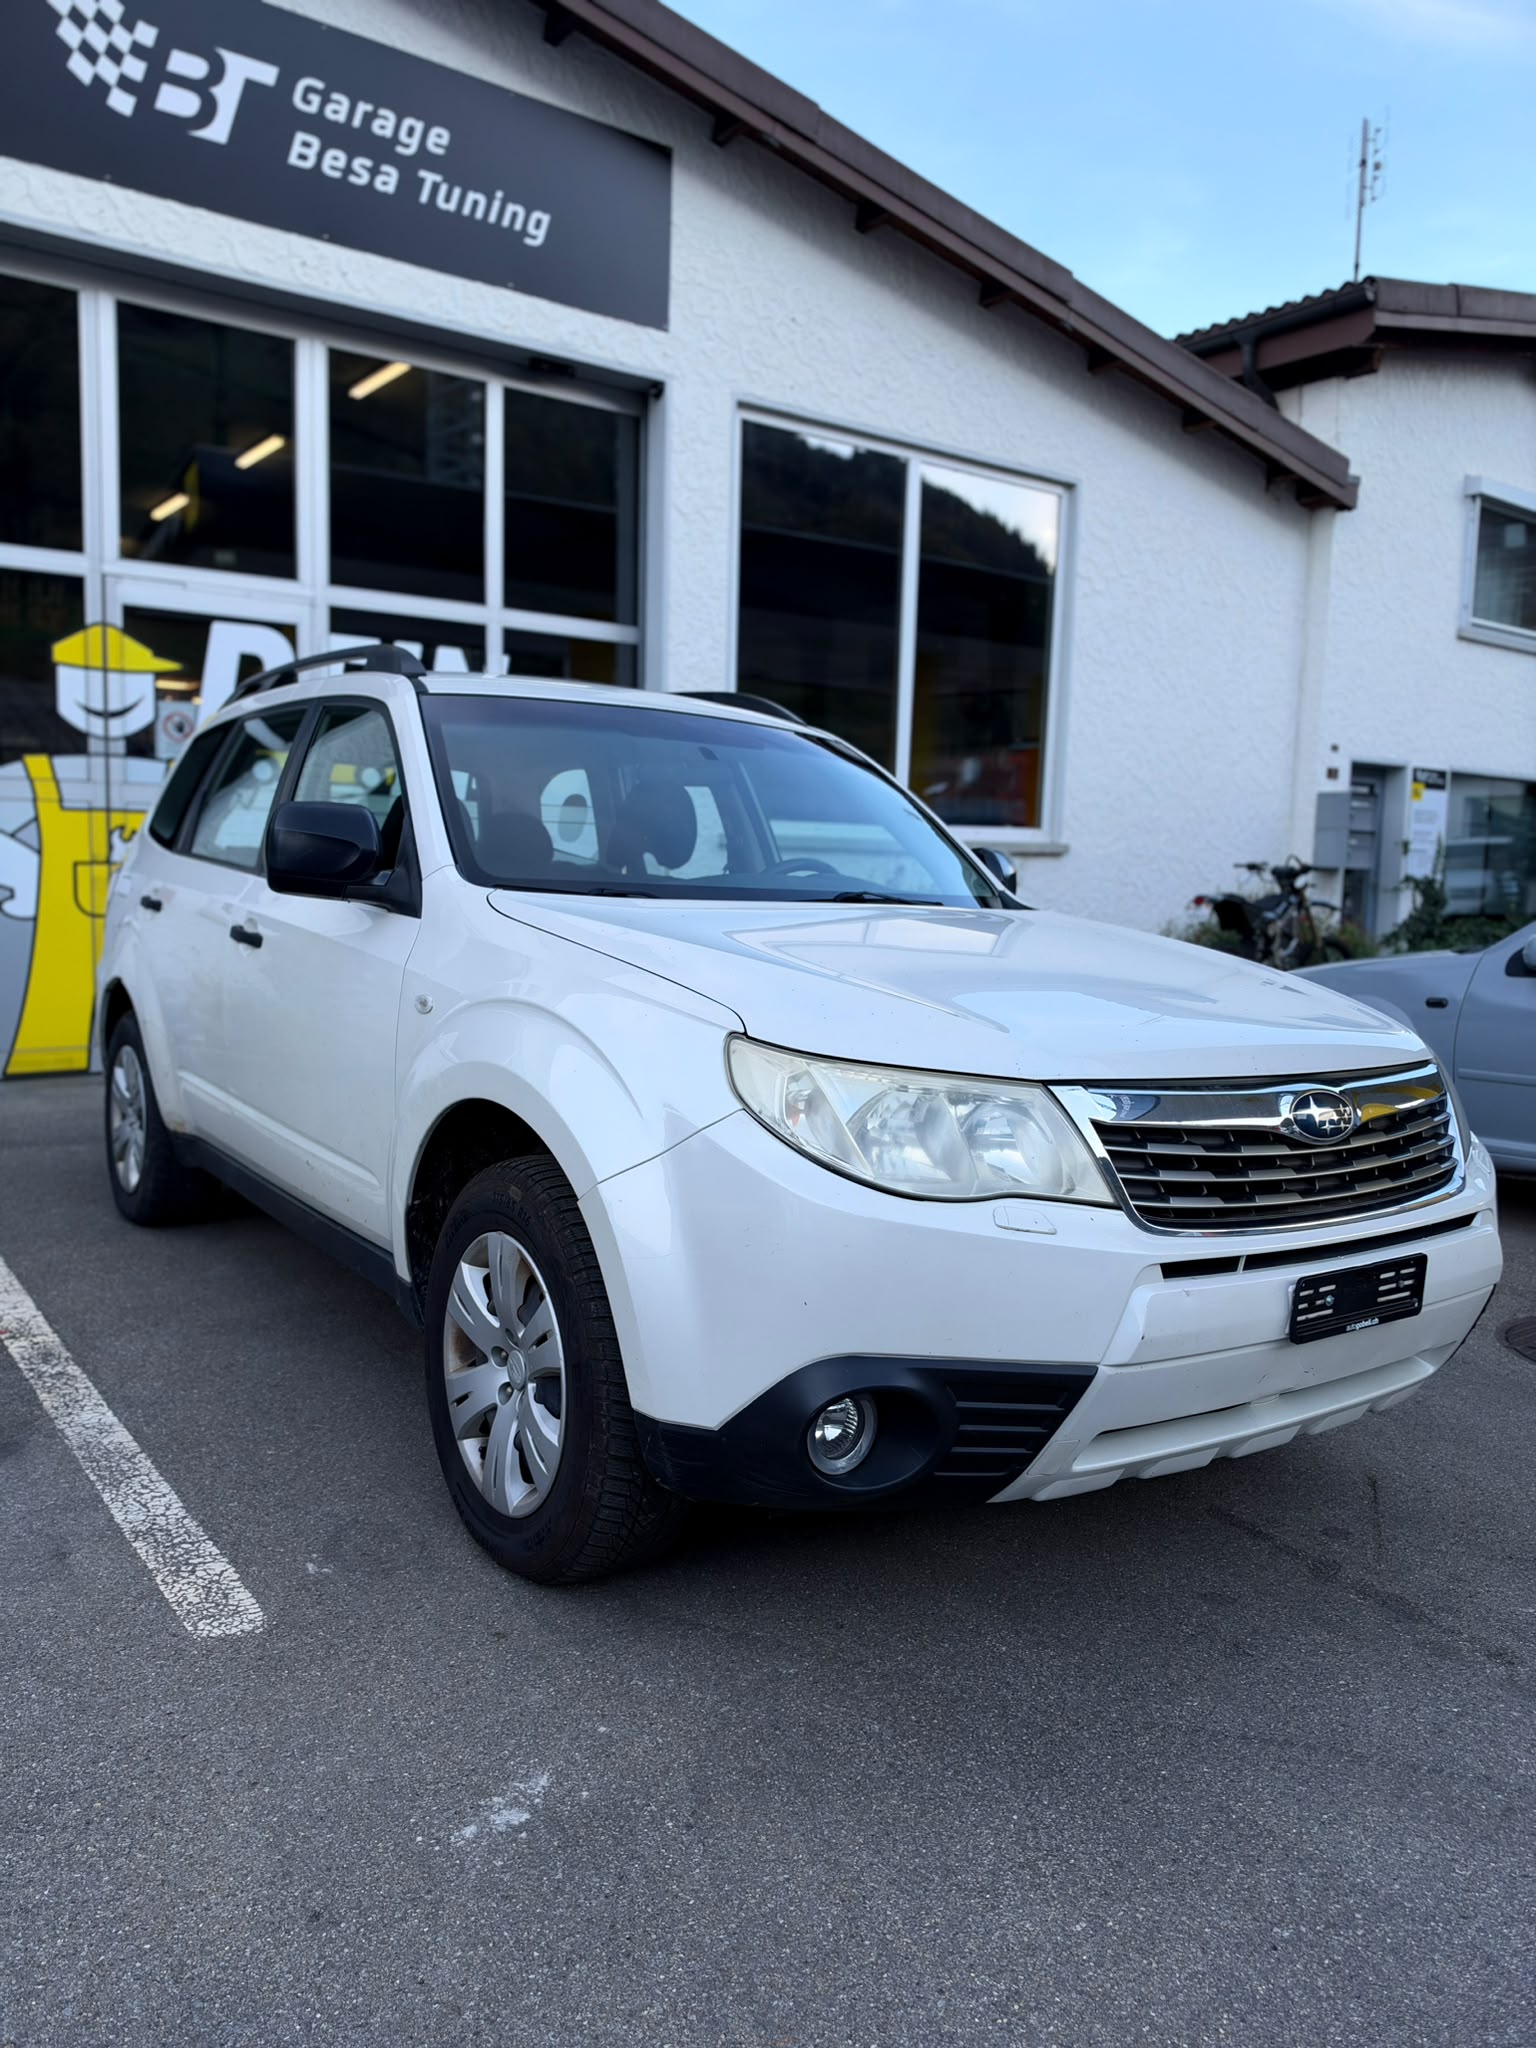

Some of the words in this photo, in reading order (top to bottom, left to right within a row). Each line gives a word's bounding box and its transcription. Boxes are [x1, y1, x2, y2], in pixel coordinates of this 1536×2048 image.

[292, 77, 451, 156] Garage
[287, 131, 399, 195] Besa
[417, 169, 551, 247] Tuning
